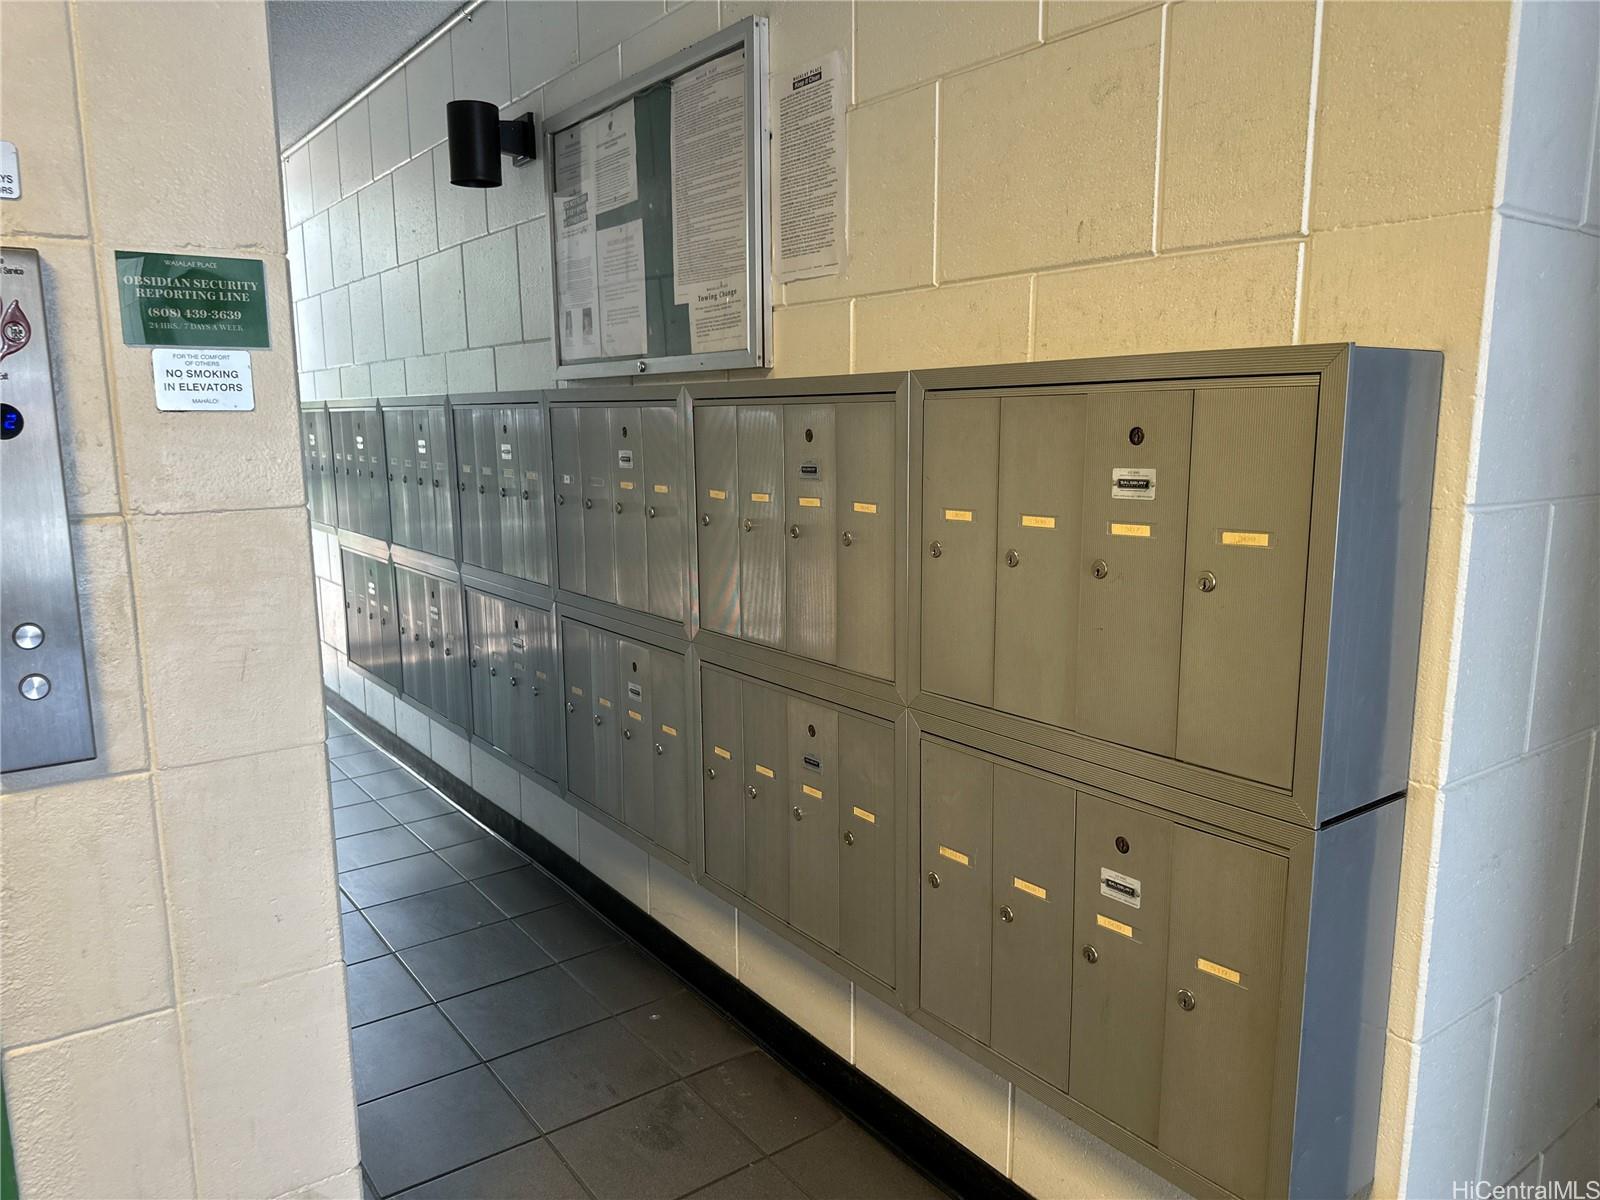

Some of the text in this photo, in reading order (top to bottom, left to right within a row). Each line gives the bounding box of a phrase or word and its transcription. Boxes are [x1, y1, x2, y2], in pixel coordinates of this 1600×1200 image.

[0, 174, 14, 184] YS
[163, 259, 218, 269] WAIALAE PLACE
[123, 275, 259, 292] OBSIDIAN SECURITY
[135, 288, 250, 302] REPORTING LINE
[147, 307, 242, 320] (808) 439-3639
[189, 323, 211, 331] DAYS
[165, 369, 239, 379] NO SMOKING
[163, 383, 243, 392] IN ELEVATORS
[3, 412, 17, 430] 2
